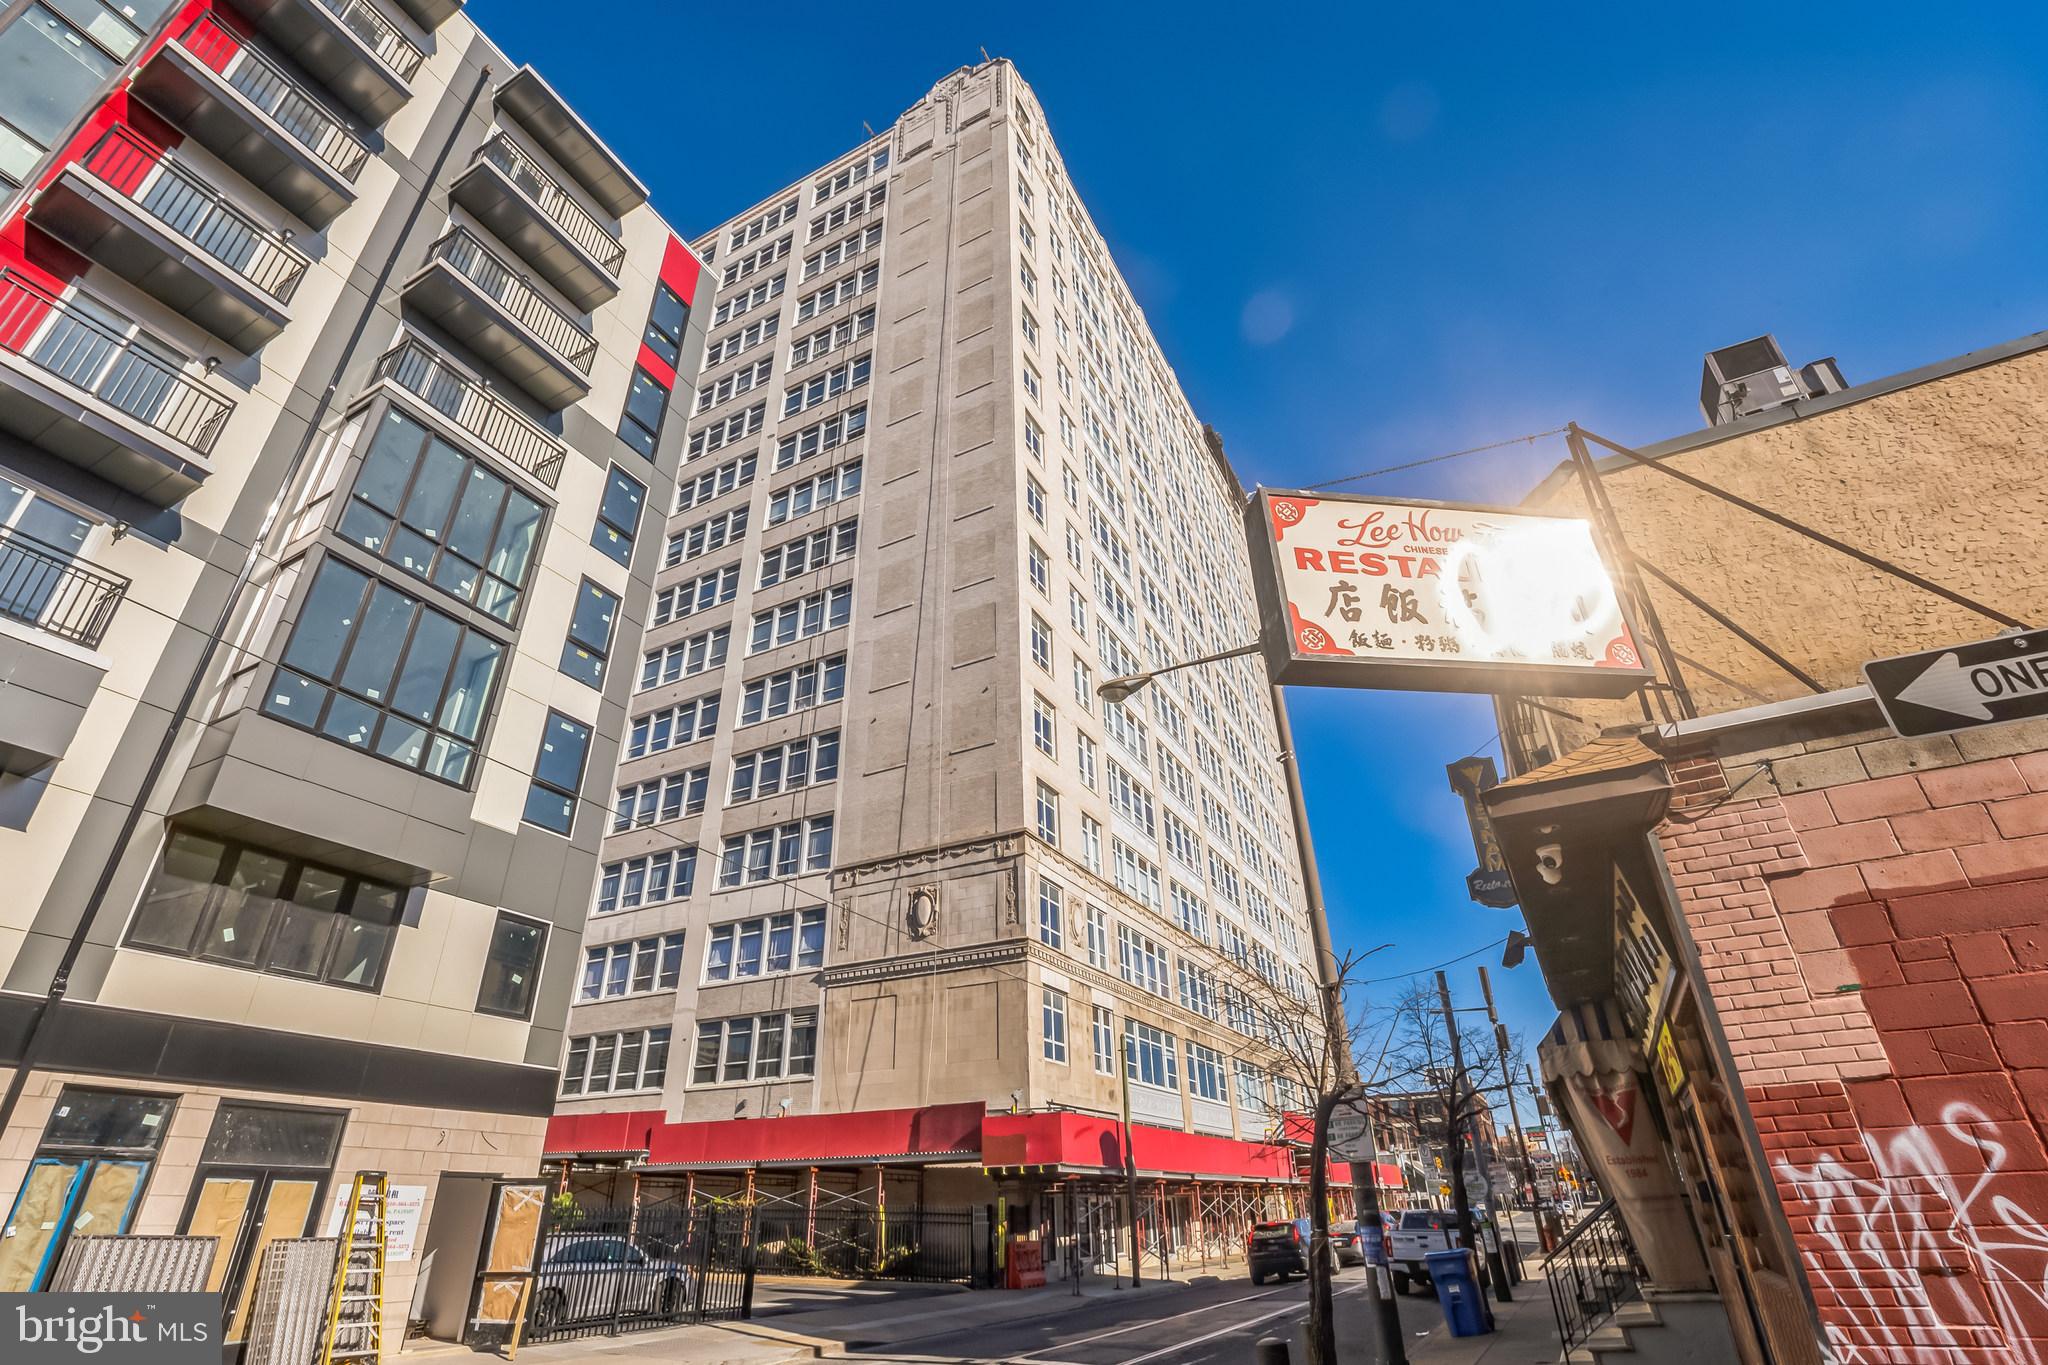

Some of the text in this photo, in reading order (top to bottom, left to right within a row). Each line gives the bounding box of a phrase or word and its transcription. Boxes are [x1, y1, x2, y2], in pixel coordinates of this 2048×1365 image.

[1337, 510, 1404, 549] Lee
[1401, 509, 1465, 543] How
[1403, 544, 1449, 556] CHINESE
[1970, 655, 2048, 698] ONE
